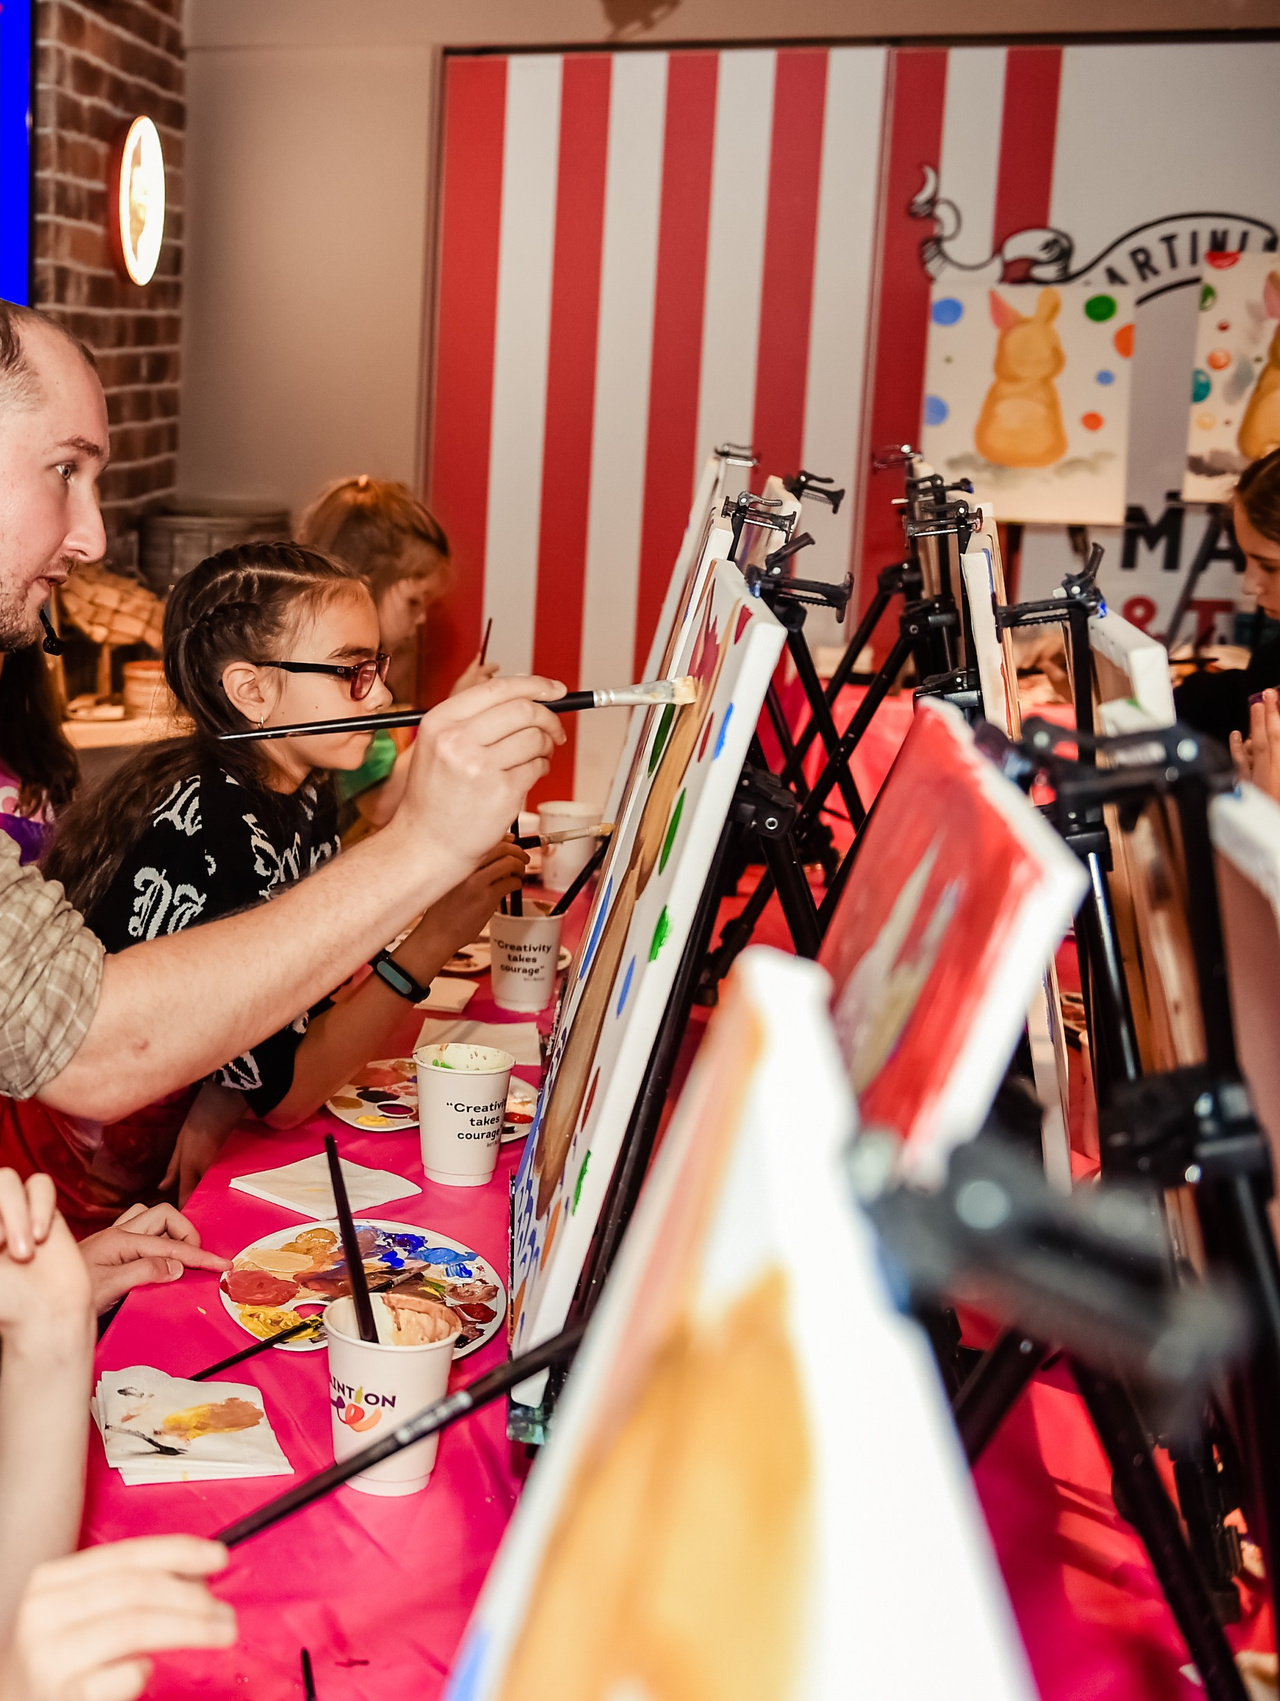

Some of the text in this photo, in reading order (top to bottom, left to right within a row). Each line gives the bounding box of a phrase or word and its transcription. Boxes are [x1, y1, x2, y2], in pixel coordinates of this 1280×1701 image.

[1082, 230, 1249, 285] ARTINI
[1122, 503, 1247, 574] MA
[469, 1115, 500, 1127] takes
